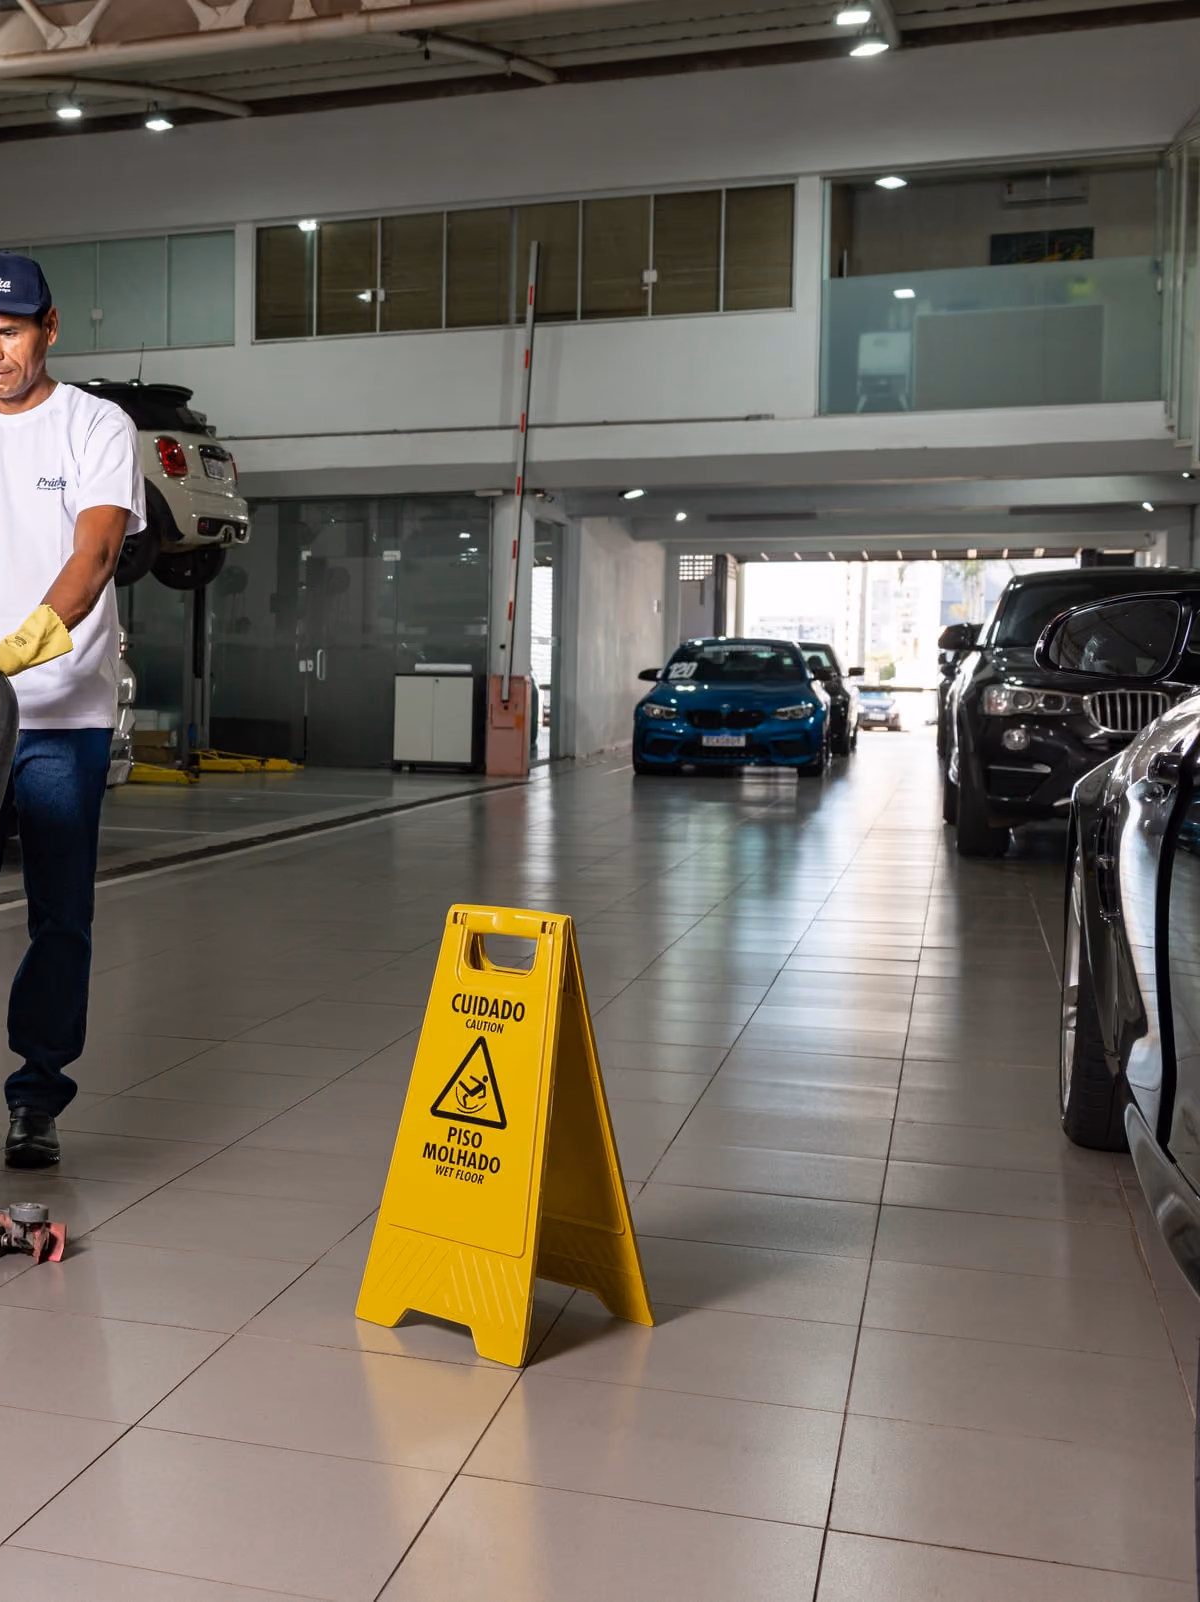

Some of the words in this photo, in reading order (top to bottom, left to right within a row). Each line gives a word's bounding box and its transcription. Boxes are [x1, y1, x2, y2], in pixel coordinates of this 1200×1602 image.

[451, 993, 525, 1022] CUIDADO
[465, 1019, 504, 1034] CAUTION
[447, 1126, 482, 1149] PISO
[422, 1142, 501, 1174] MOLHADO
[435, 1164, 455, 1178] WET
[455, 1169, 485, 1185] FLOOR
